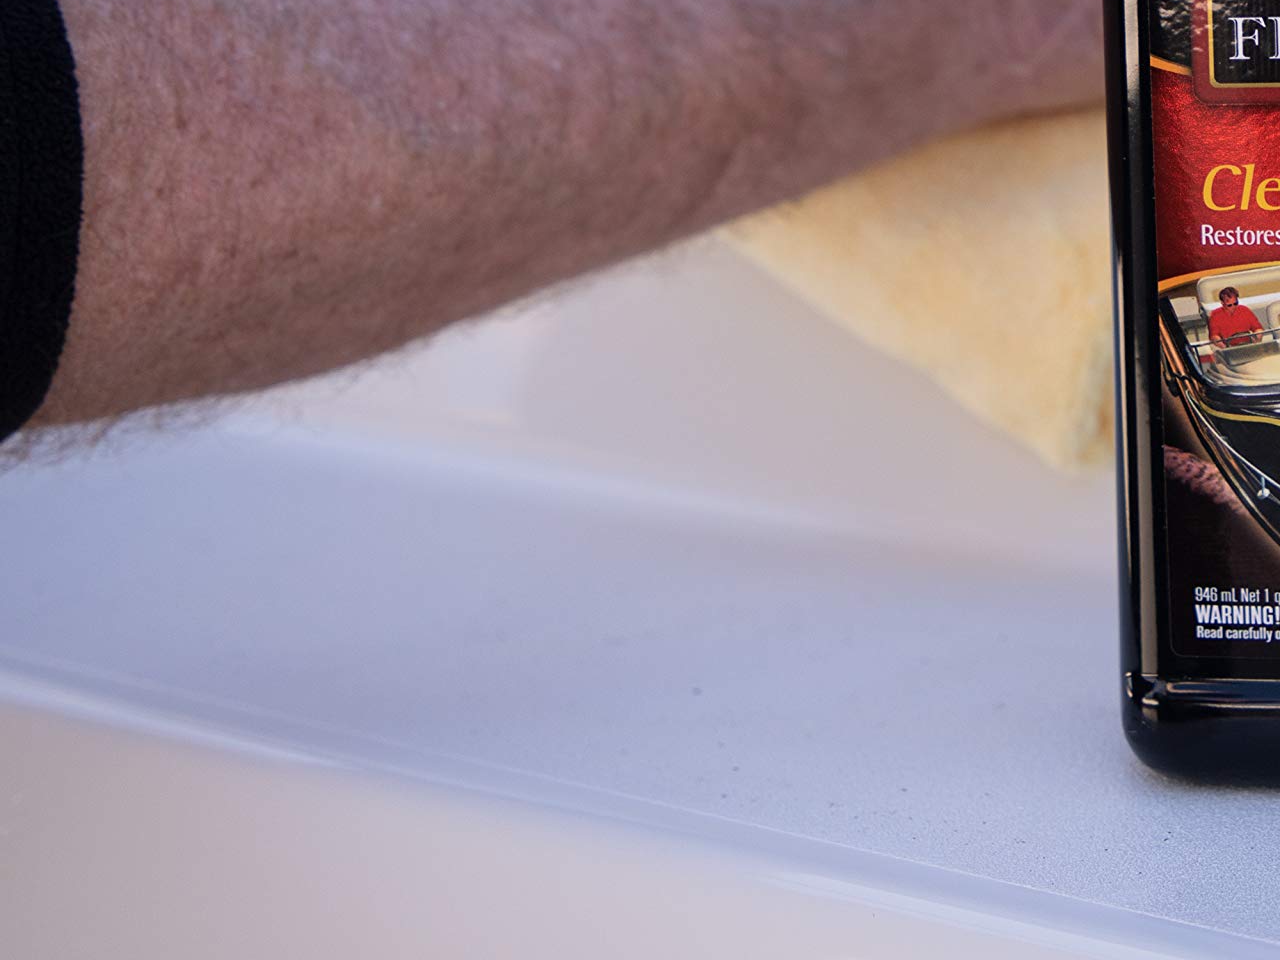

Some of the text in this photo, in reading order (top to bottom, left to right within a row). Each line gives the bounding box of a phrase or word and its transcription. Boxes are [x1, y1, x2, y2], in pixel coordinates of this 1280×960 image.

[1195, 587, 1218, 602] 946
[1241, 588, 1260, 602] Net
[1264, 589, 1269, 602] 1
[1195, 605, 1280, 625] WARNING!
[1196, 626, 1223, 638] Read
[1225, 627, 1272, 642] carefully
